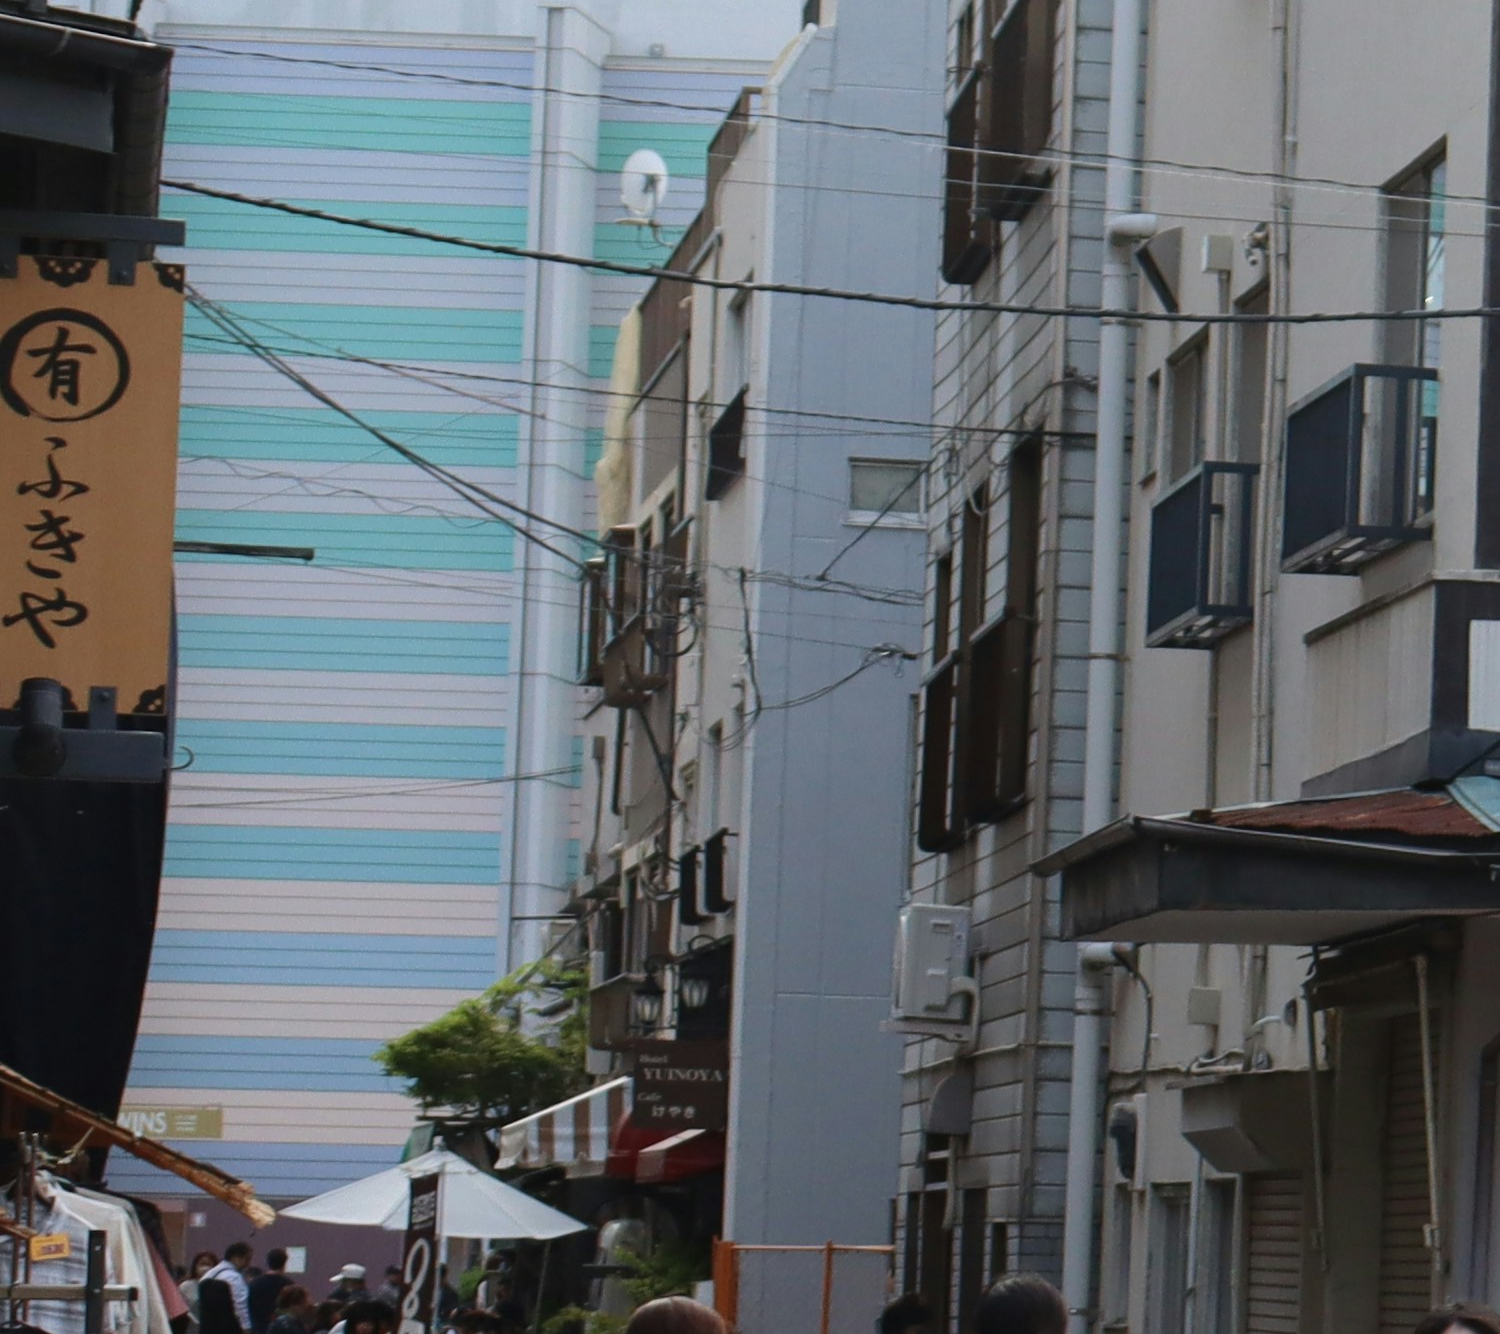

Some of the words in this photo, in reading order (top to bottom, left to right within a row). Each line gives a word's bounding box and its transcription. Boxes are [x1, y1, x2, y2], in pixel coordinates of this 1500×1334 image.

[2, 436, 90, 649] ふきや
[643, 1067, 723, 1081] YUINOYA
[651, 1105, 695, 1119] けやき
